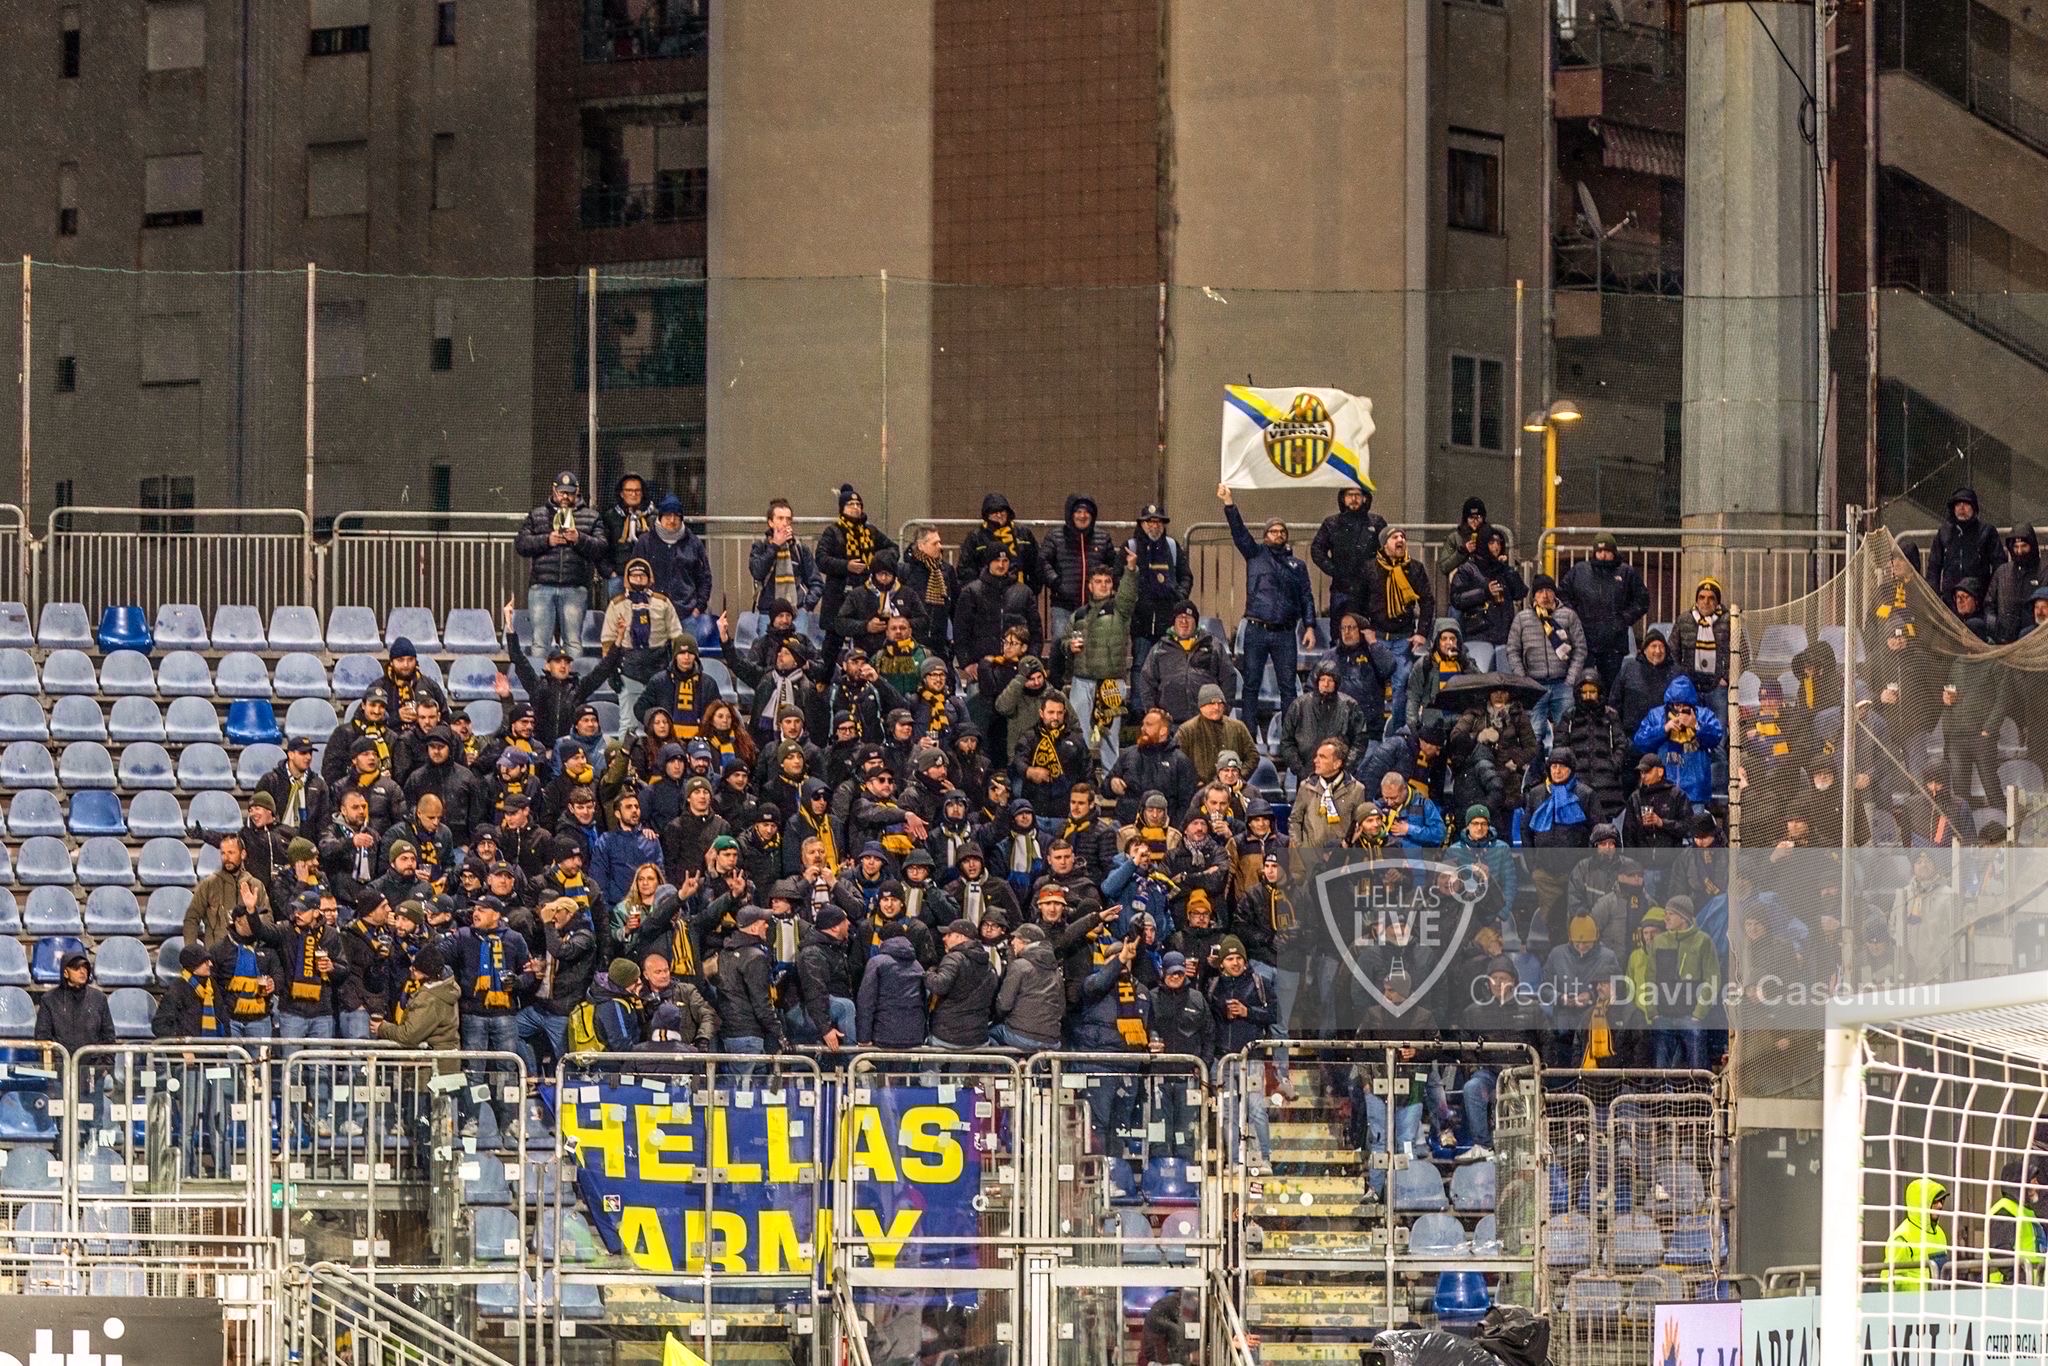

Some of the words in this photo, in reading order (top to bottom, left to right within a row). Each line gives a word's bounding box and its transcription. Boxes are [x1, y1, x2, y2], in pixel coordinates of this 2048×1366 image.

[1269, 429, 1329, 439] VERONA
[303, 935, 316, 978] SIAMO
[562, 1104, 964, 1183] HELLAS
[618, 1206, 923, 1285] ARMY
